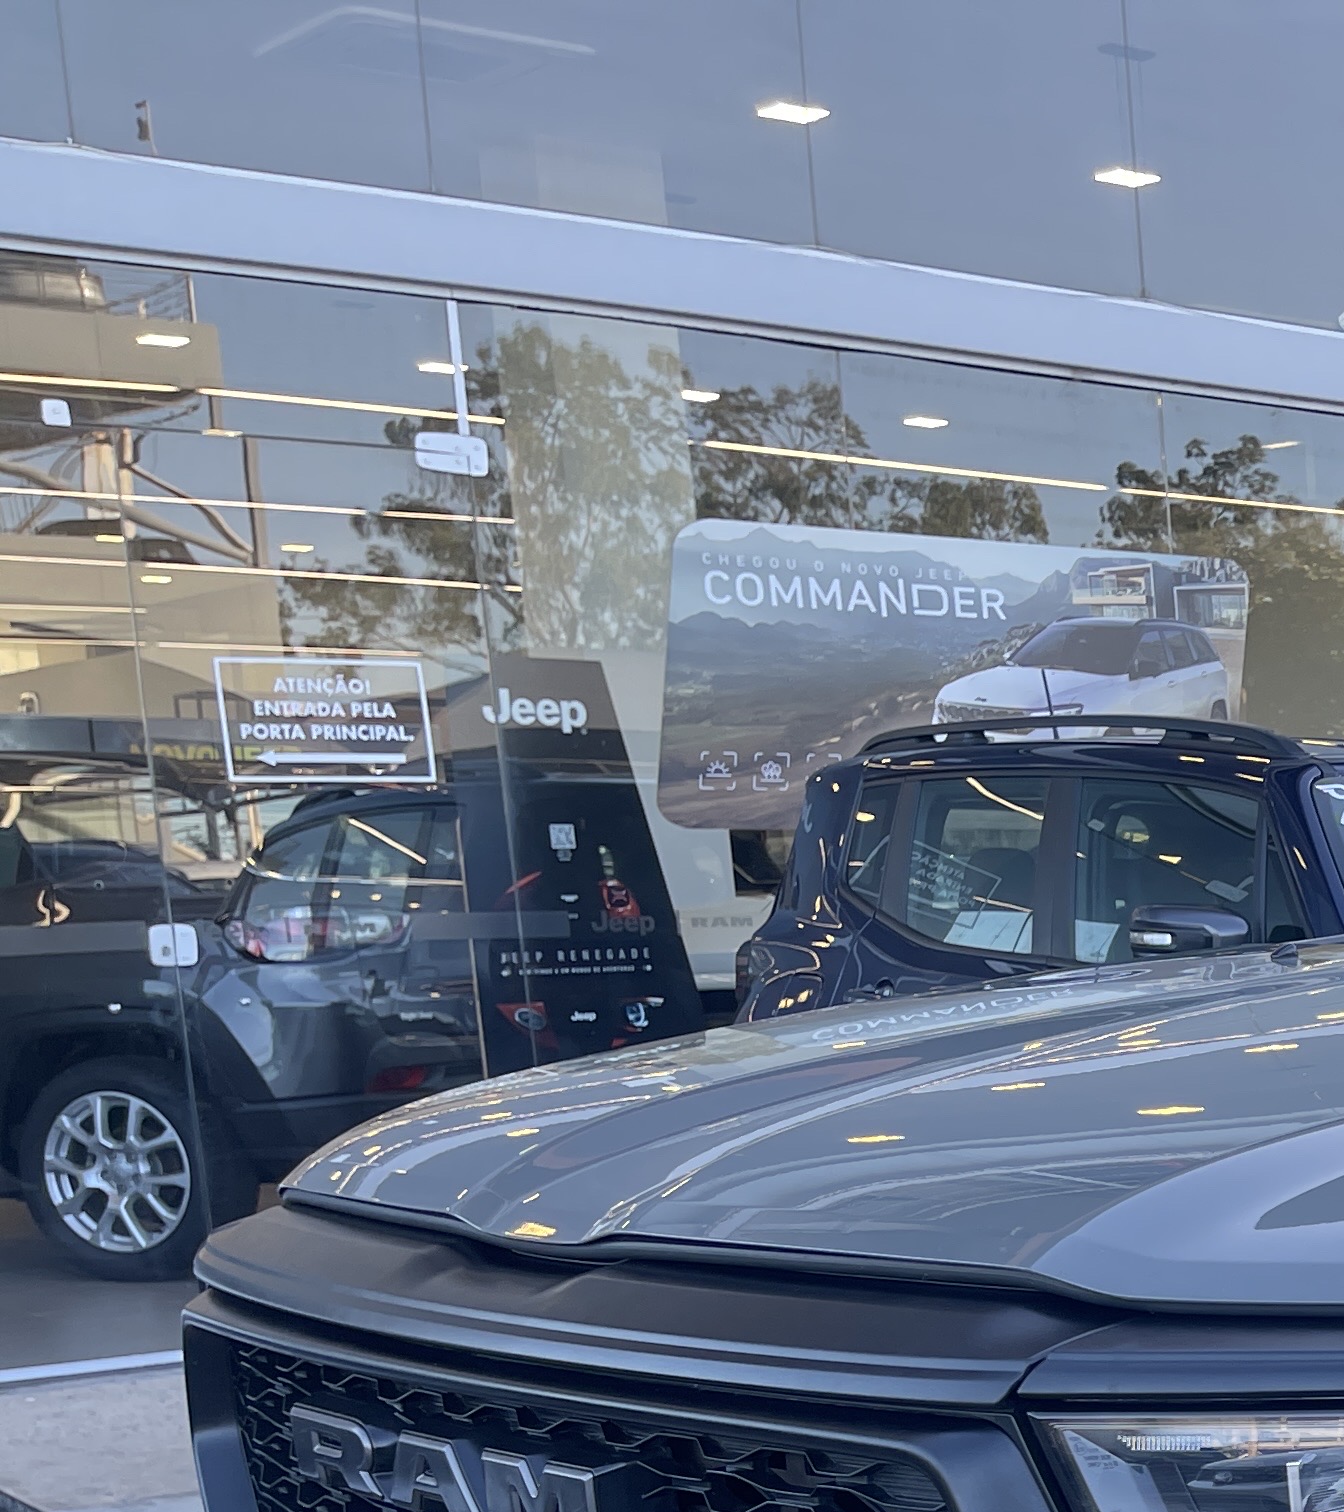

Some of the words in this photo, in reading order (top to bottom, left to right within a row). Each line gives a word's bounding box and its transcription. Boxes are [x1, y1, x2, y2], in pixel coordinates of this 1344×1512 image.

[702, 552, 797, 571] CHEGOU
[813, 560, 825, 573] O
[841, 562, 899, 578] NOVO
[915, 567, 968, 582] JEEP
[703, 569, 1008, 621] COMMANDER
[273, 674, 371, 698] ATENÇÃO!
[253, 700, 346, 718] ENTRADA
[350, 702, 397, 719] PELA
[482, 688, 588, 735] Jeep
[239, 723, 306, 741] PORTA
[311, 723, 416, 742] PRINCIPAL.
[591, 910, 656, 936] Jeep
[691, 917, 754, 928] RAM
[557, 947, 651, 963] RENEGADE
